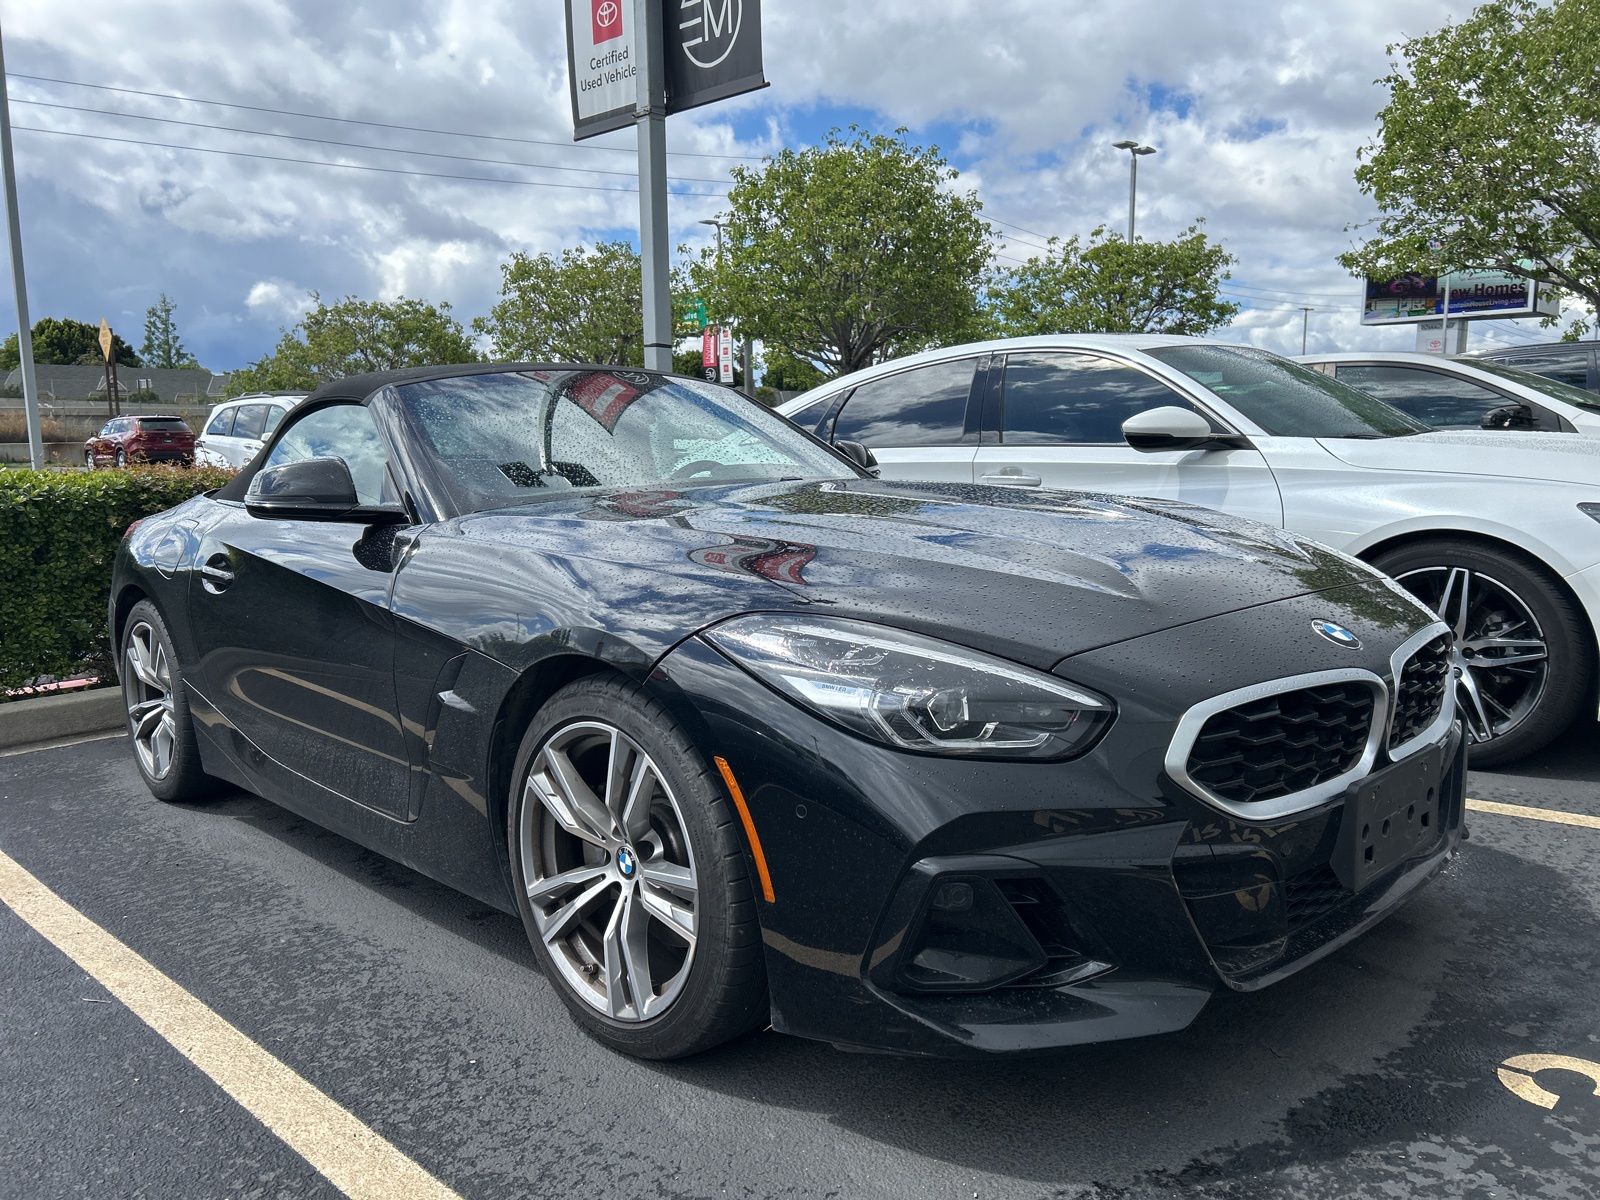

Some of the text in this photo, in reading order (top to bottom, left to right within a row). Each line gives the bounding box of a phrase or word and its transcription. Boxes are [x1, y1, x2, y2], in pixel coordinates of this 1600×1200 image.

[590, 45, 629, 70] Certified
[580, 74, 603, 92] Used
[1474, 282, 1526, 296] Homes
